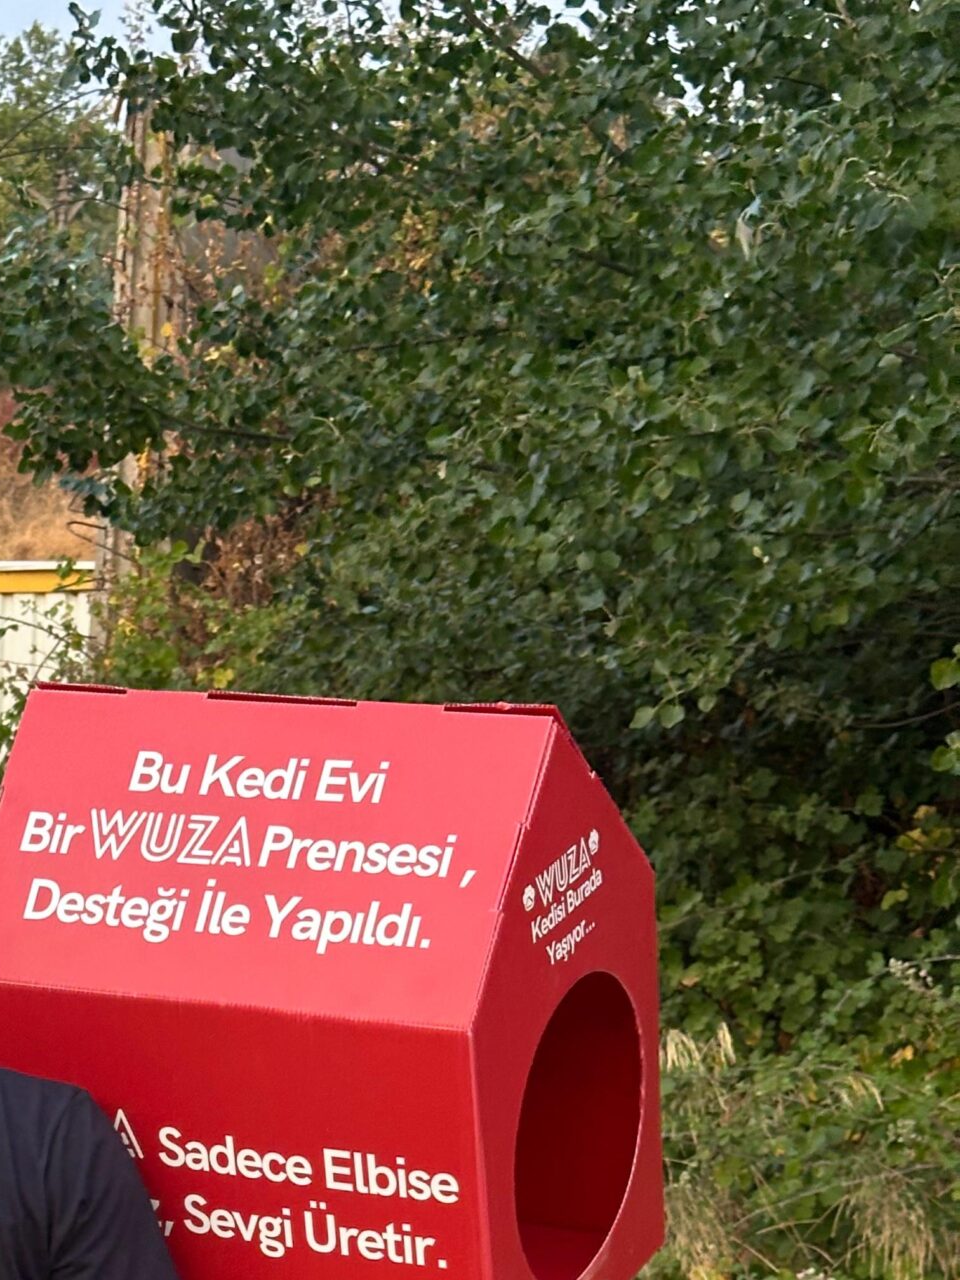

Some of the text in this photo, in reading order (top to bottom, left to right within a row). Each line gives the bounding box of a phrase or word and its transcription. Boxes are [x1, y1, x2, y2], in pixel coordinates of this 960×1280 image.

[128, 750, 390, 804] Bu Kedi Evi
[19, 811, 86, 854] Bir
[90, 808, 252, 867] WUZA
[534, 836, 592, 908] WUZA
[23, 878, 431, 955] Desteği İle Yapıldı.
[530, 867, 603, 944] Kedisi Burada
[158, 1126, 313, 1186] Sadece
[322, 1148, 460, 1204] Elbise
[183, 1193, 294, 1258] Sevgi
[303, 1200, 448, 1269] Üretir.
